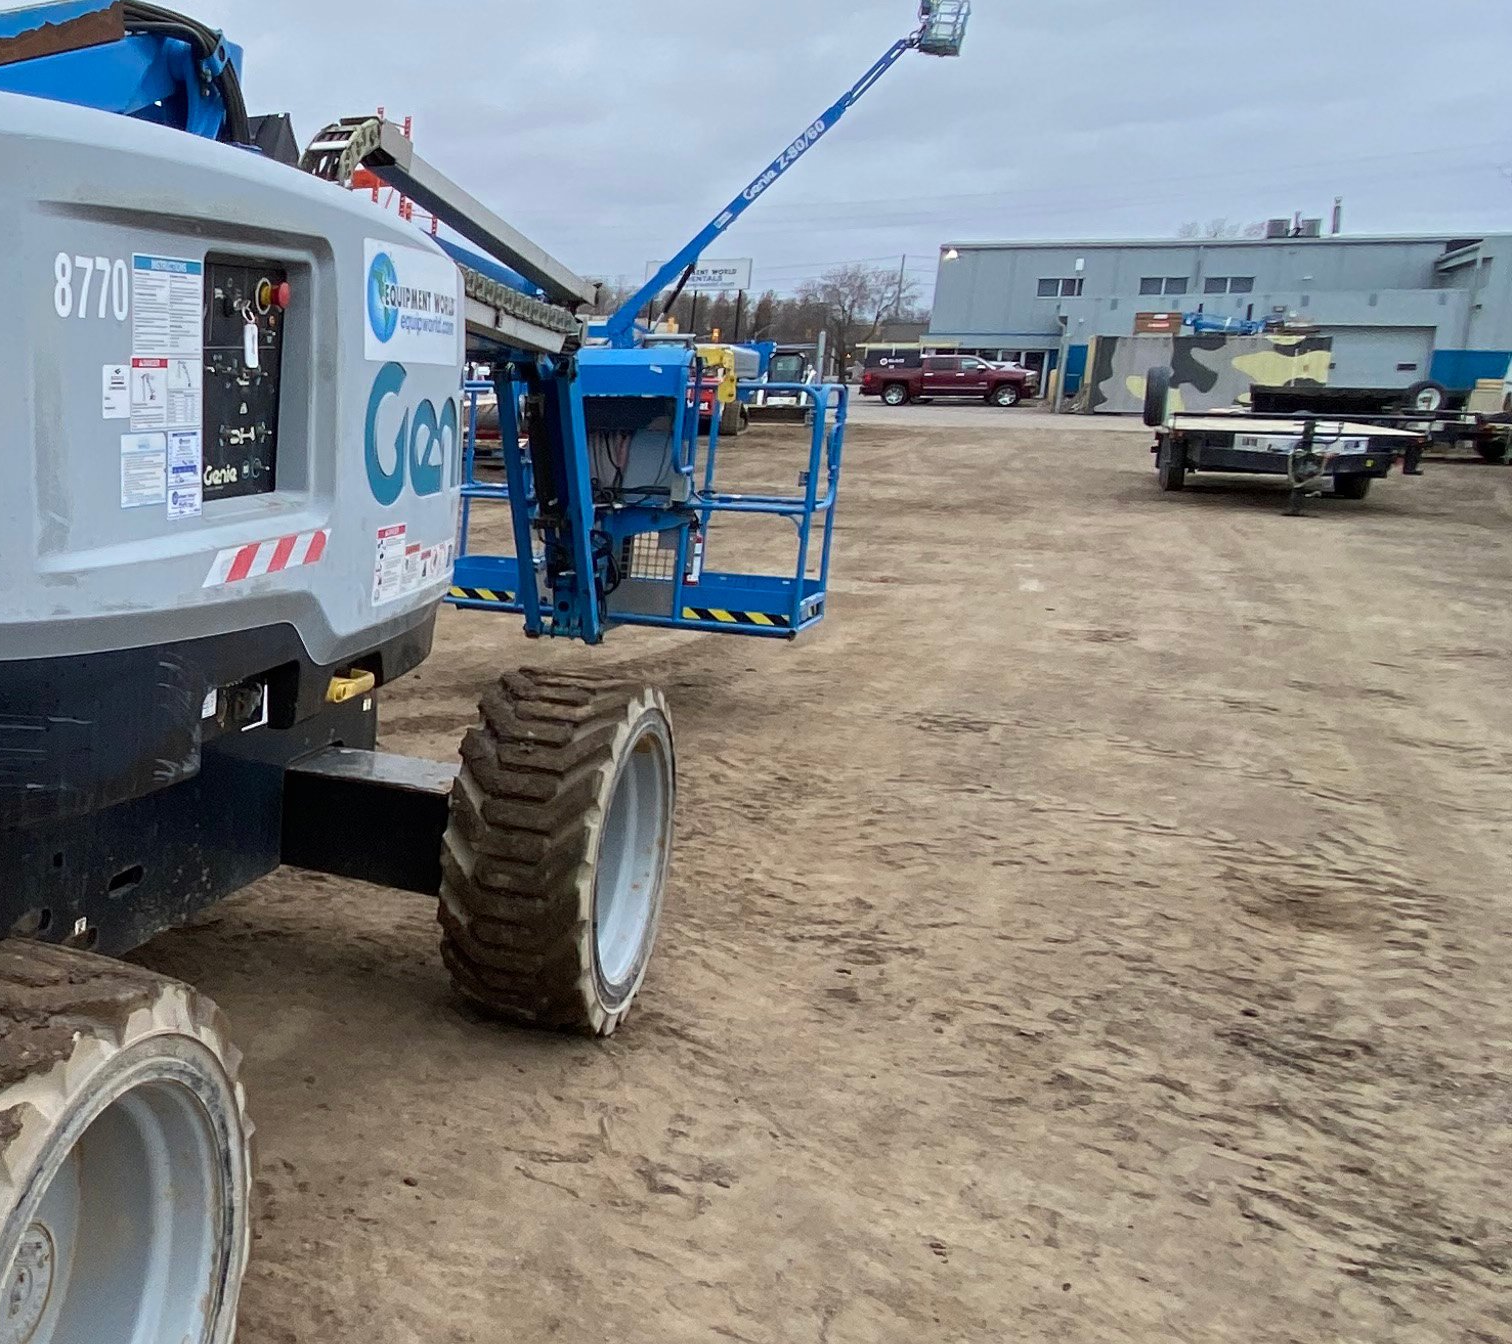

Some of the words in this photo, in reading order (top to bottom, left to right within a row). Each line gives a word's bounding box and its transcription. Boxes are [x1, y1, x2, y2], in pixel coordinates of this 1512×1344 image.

[54, 252, 128, 321] 8770
[385, 284, 431, 311] EQUIPMENT
[364, 361, 459, 506] Gen
[203, 464, 237, 486] Genie
